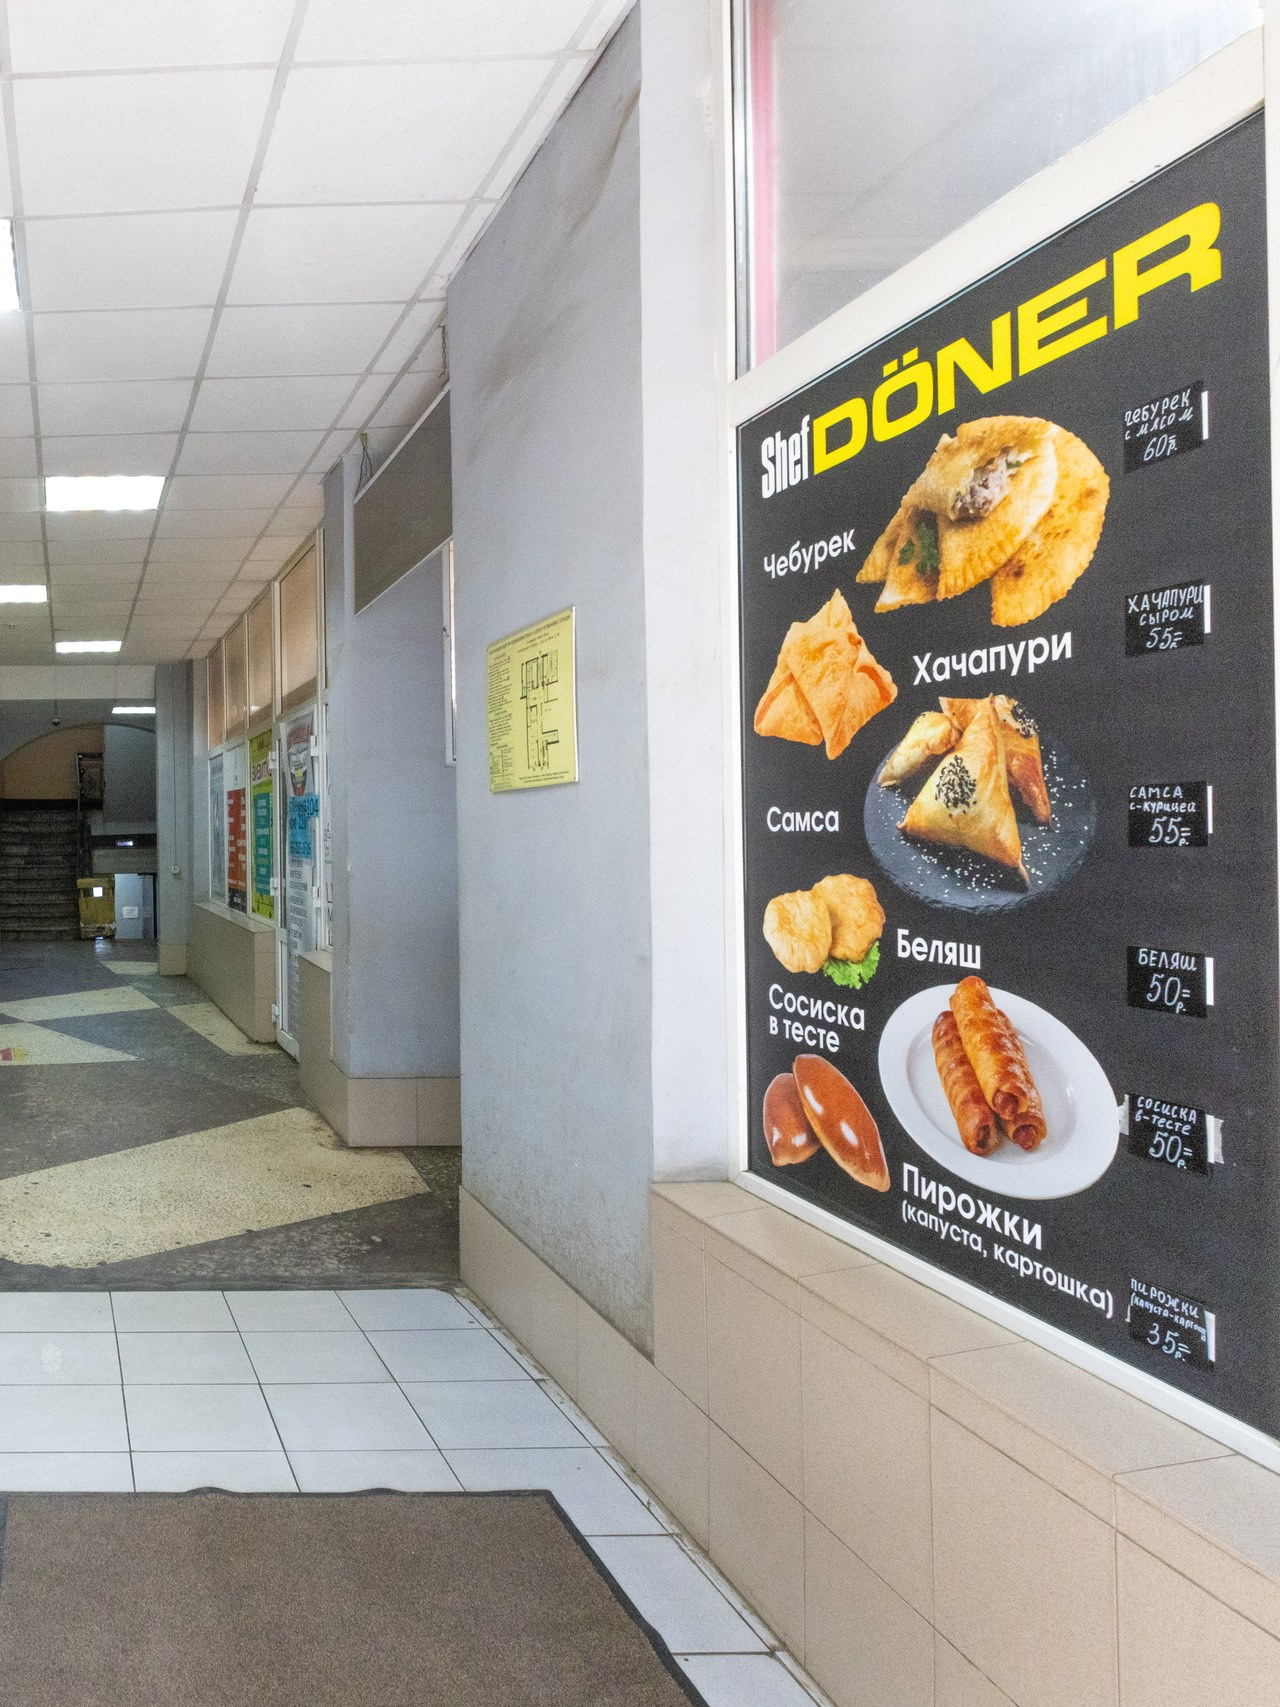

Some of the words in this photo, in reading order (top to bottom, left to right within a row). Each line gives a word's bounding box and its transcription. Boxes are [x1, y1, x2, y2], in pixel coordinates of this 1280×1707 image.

[761, 414, 810, 500] Shef
[813, 202, 1222, 476] DÖNER
[763, 529, 857, 579] Чебурек
[1128, 585, 1203, 613] ХАЧАПУРИ
[912, 632, 1073, 686] Хачапури
[1130, 786, 1183, 799] САМСА
[766, 806, 840, 833] Самса
[897, 929, 982, 970] Беляш
[1139, 948, 1196, 971] БЕЛЯШ
[768, 983, 865, 1031] Сосиска
[769, 1017, 778, 1035] в
[782, 1019, 840, 1054] тесте
[1137, 1097, 1197, 1124] СОСИСКА
[902, 1162, 1043, 1251] Пирожки
[901, 1203, 987, 1258] (капуста,
[993, 1242, 1114, 1320] картошка)
[1131, 1278, 1199, 1318] ПИРОЖКИ
